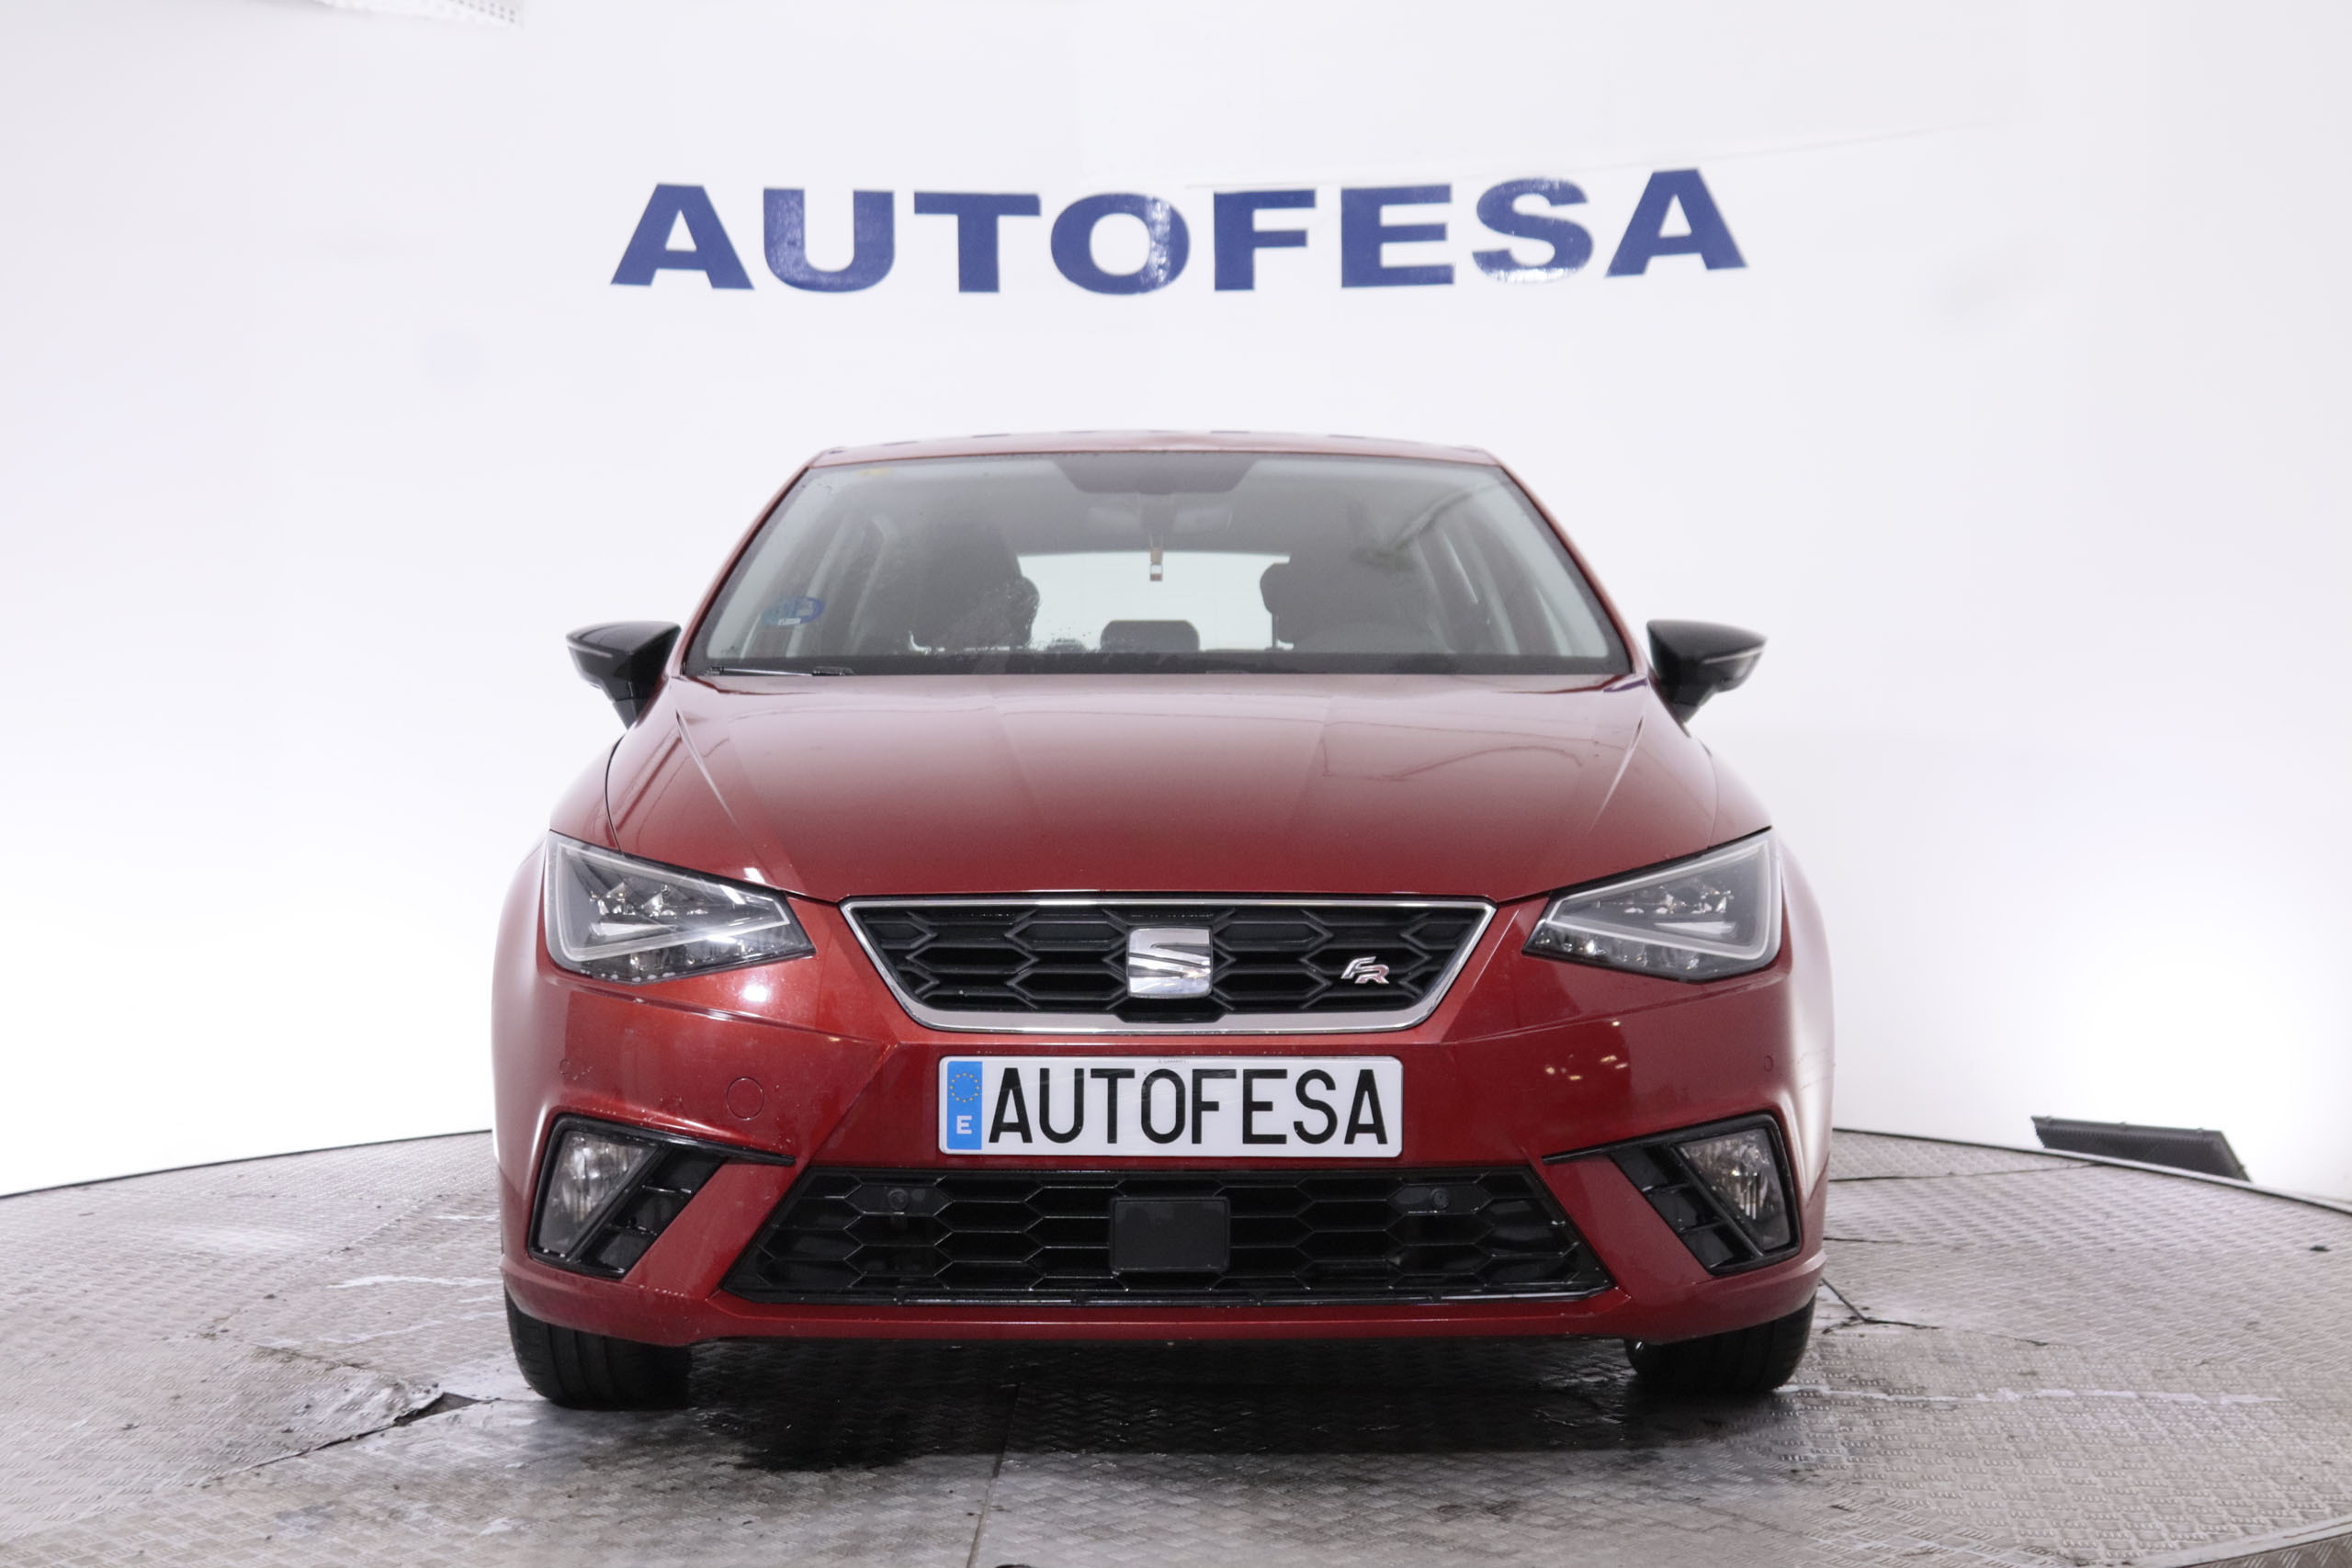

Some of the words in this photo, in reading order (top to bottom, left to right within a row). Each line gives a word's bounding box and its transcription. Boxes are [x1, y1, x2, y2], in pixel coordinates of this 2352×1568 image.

[610, 168, 1748, 296] AUTOFESA
[956, 1115, 973, 1134] E
[988, 1067, 1389, 1145] AUTOFESA
